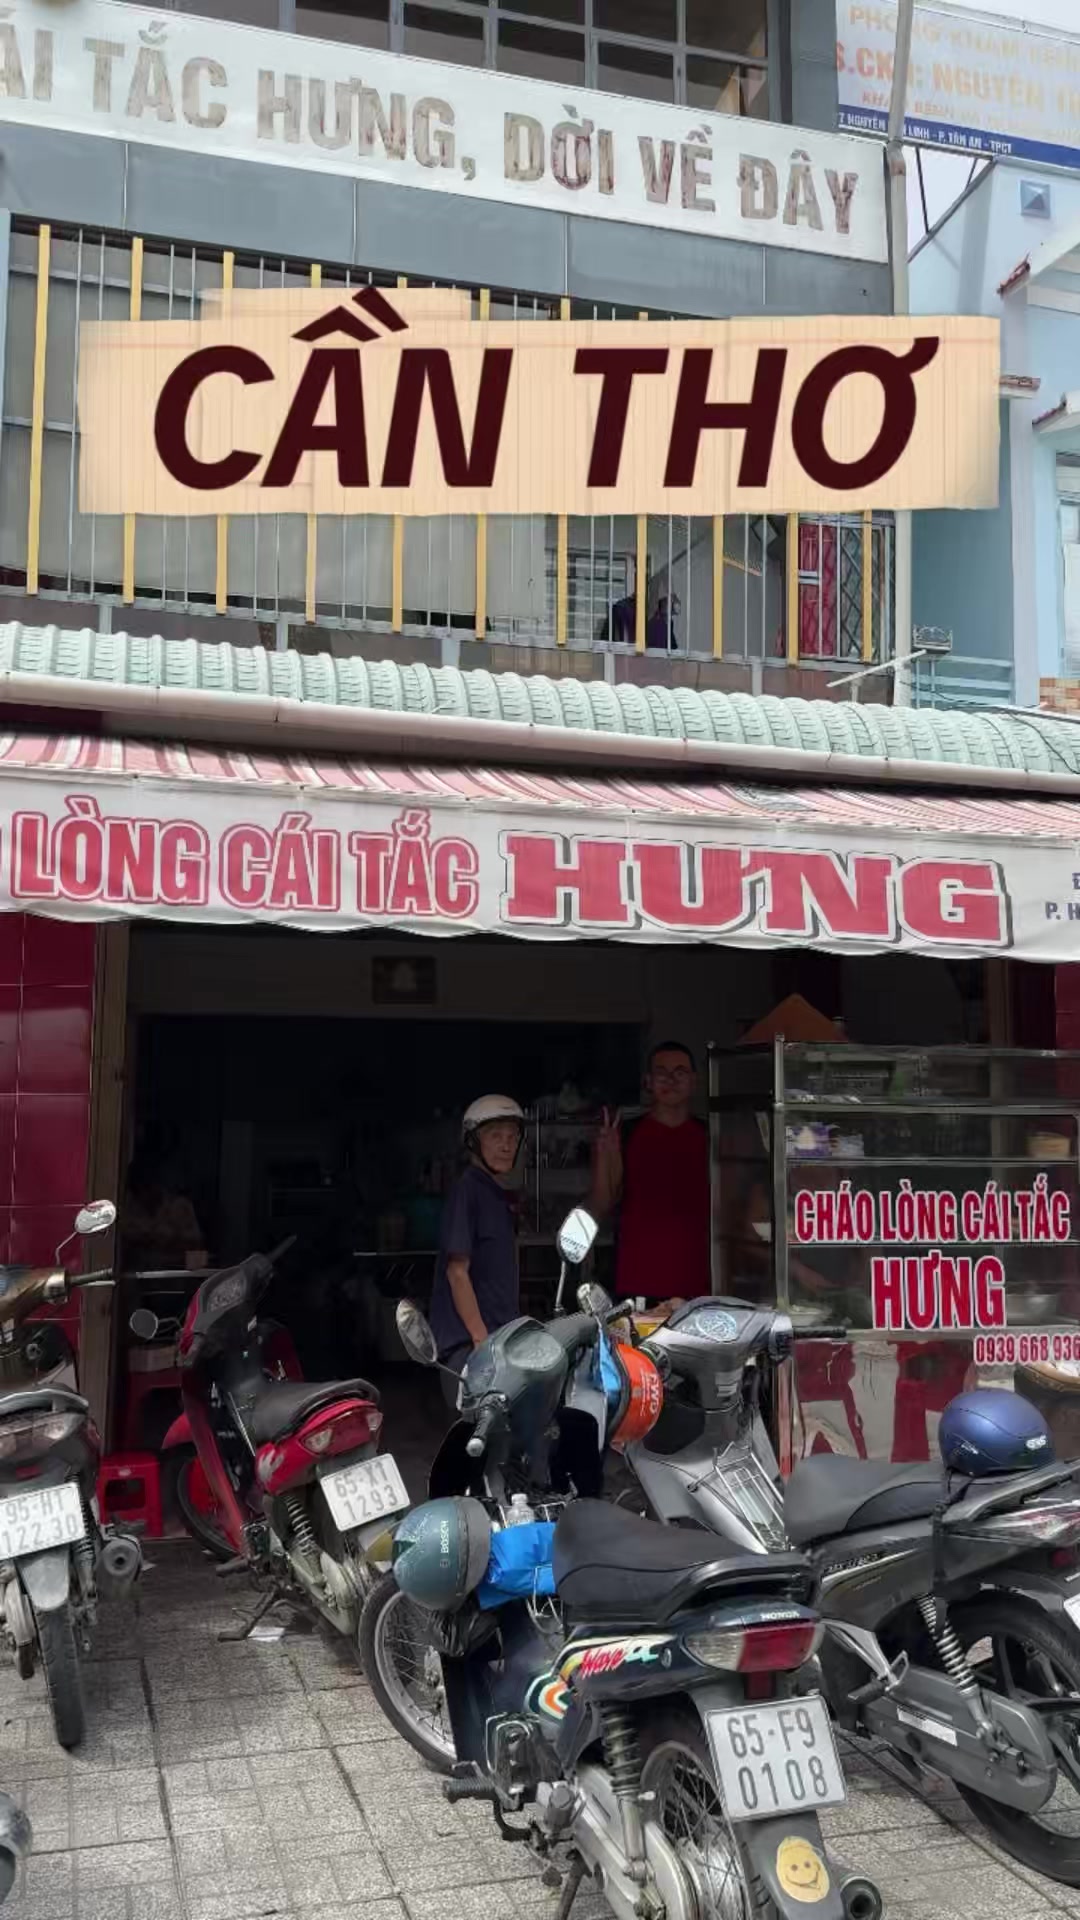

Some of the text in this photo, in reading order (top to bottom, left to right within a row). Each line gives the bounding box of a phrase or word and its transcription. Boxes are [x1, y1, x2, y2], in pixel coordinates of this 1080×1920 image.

[83, 20, 228, 129] TẮC
[257, 68, 477, 181] HƯNG,
[504, 103, 614, 195] DỜI
[637, 123, 716, 214] VỀ
[736, 148, 859, 235] ĐÂY
[10, 794, 209, 906] LÒNG
[219, 811, 341, 912] CÁI
[351, 807, 480, 918] TẮC
[499, 830, 1014, 948] HƯNG
[795, 1173, 1071, 1242] CHÁO LÒNG CÁI TẮC
[871, 1250, 1006, 1330] HƯNG
[974, 1335, 1016, 1365] 0939
[1019, 1334, 1048, 1364] 668
[344, 1484, 398, 1521] 1293
[440, 1519, 449, 1554] BOSCH
[726, 1708, 816, 1758] 65-F9
[738, 1755, 829, 1810] 0108
